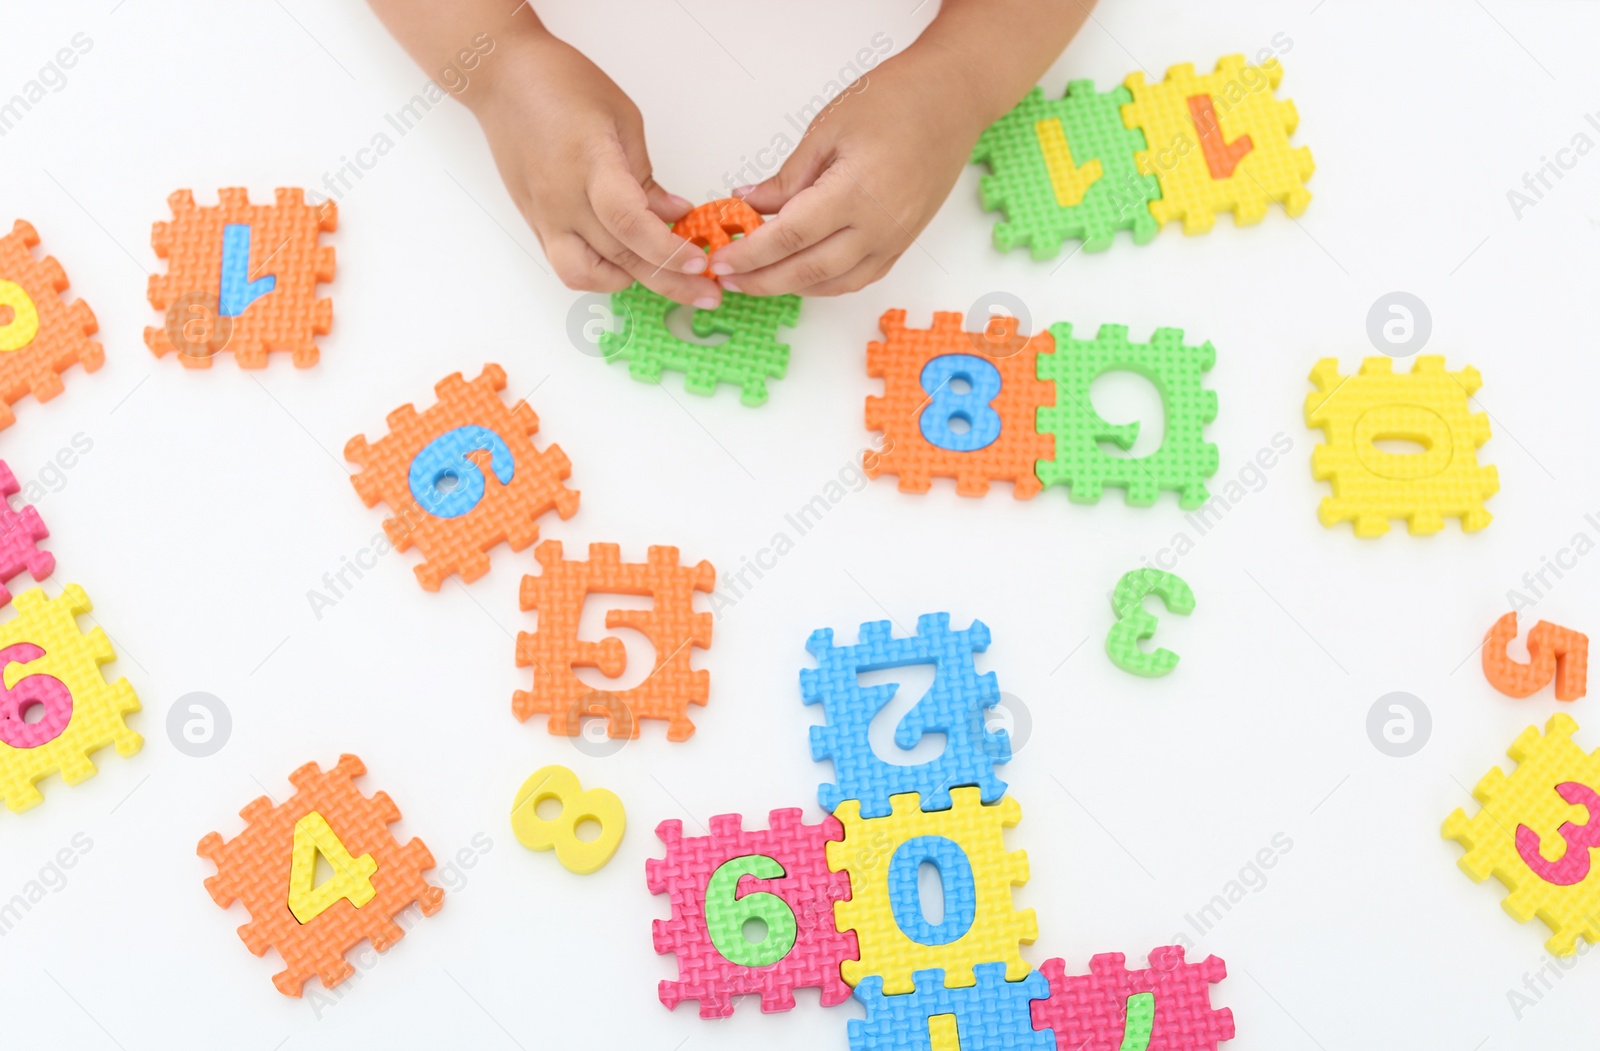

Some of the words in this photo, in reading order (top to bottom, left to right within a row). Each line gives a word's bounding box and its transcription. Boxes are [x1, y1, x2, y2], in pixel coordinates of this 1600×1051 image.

[1034, 117, 1103, 207] 1
[1187, 93, 1254, 180] 1
[219, 224, 276, 316] 1
[920, 353, 1003, 452] 8
[1353, 402, 1454, 481] 0
[569, 589, 657, 691] 5
[1105, 567, 1196, 678] 3
[1482, 611, 1589, 702] 5
[287, 810, 379, 925] 4
[510, 764, 626, 874] 8
[1515, 781, 1600, 886] 3
[705, 854, 798, 967] 6
[888, 835, 976, 946] 0
